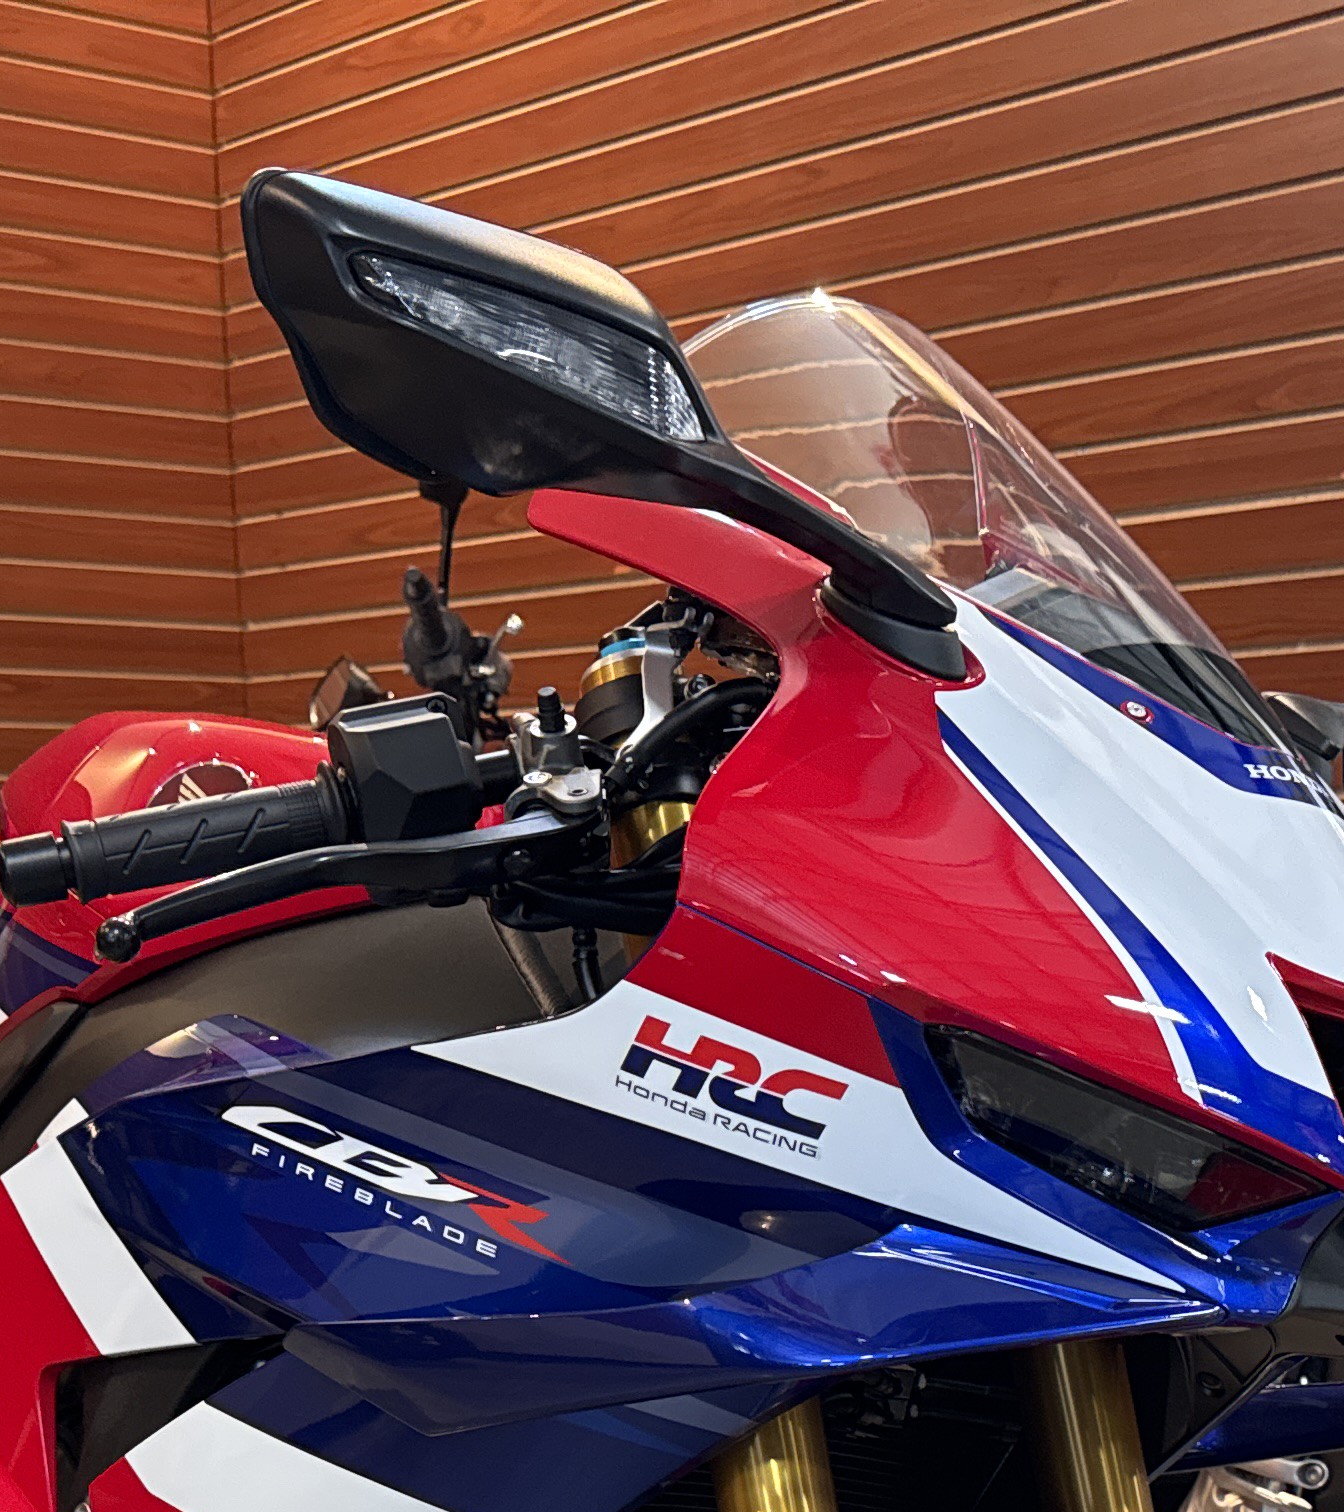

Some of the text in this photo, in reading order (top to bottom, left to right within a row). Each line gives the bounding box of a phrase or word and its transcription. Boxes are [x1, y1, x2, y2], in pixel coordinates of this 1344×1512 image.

[1242, 762, 1334, 800] HON
[614, 1074, 820, 1159] Honda RACING
[620, 1014, 850, 1140] HRC
[221, 1105, 573, 1266] CBR
[251, 1142, 498, 1258] FIREBLADE
